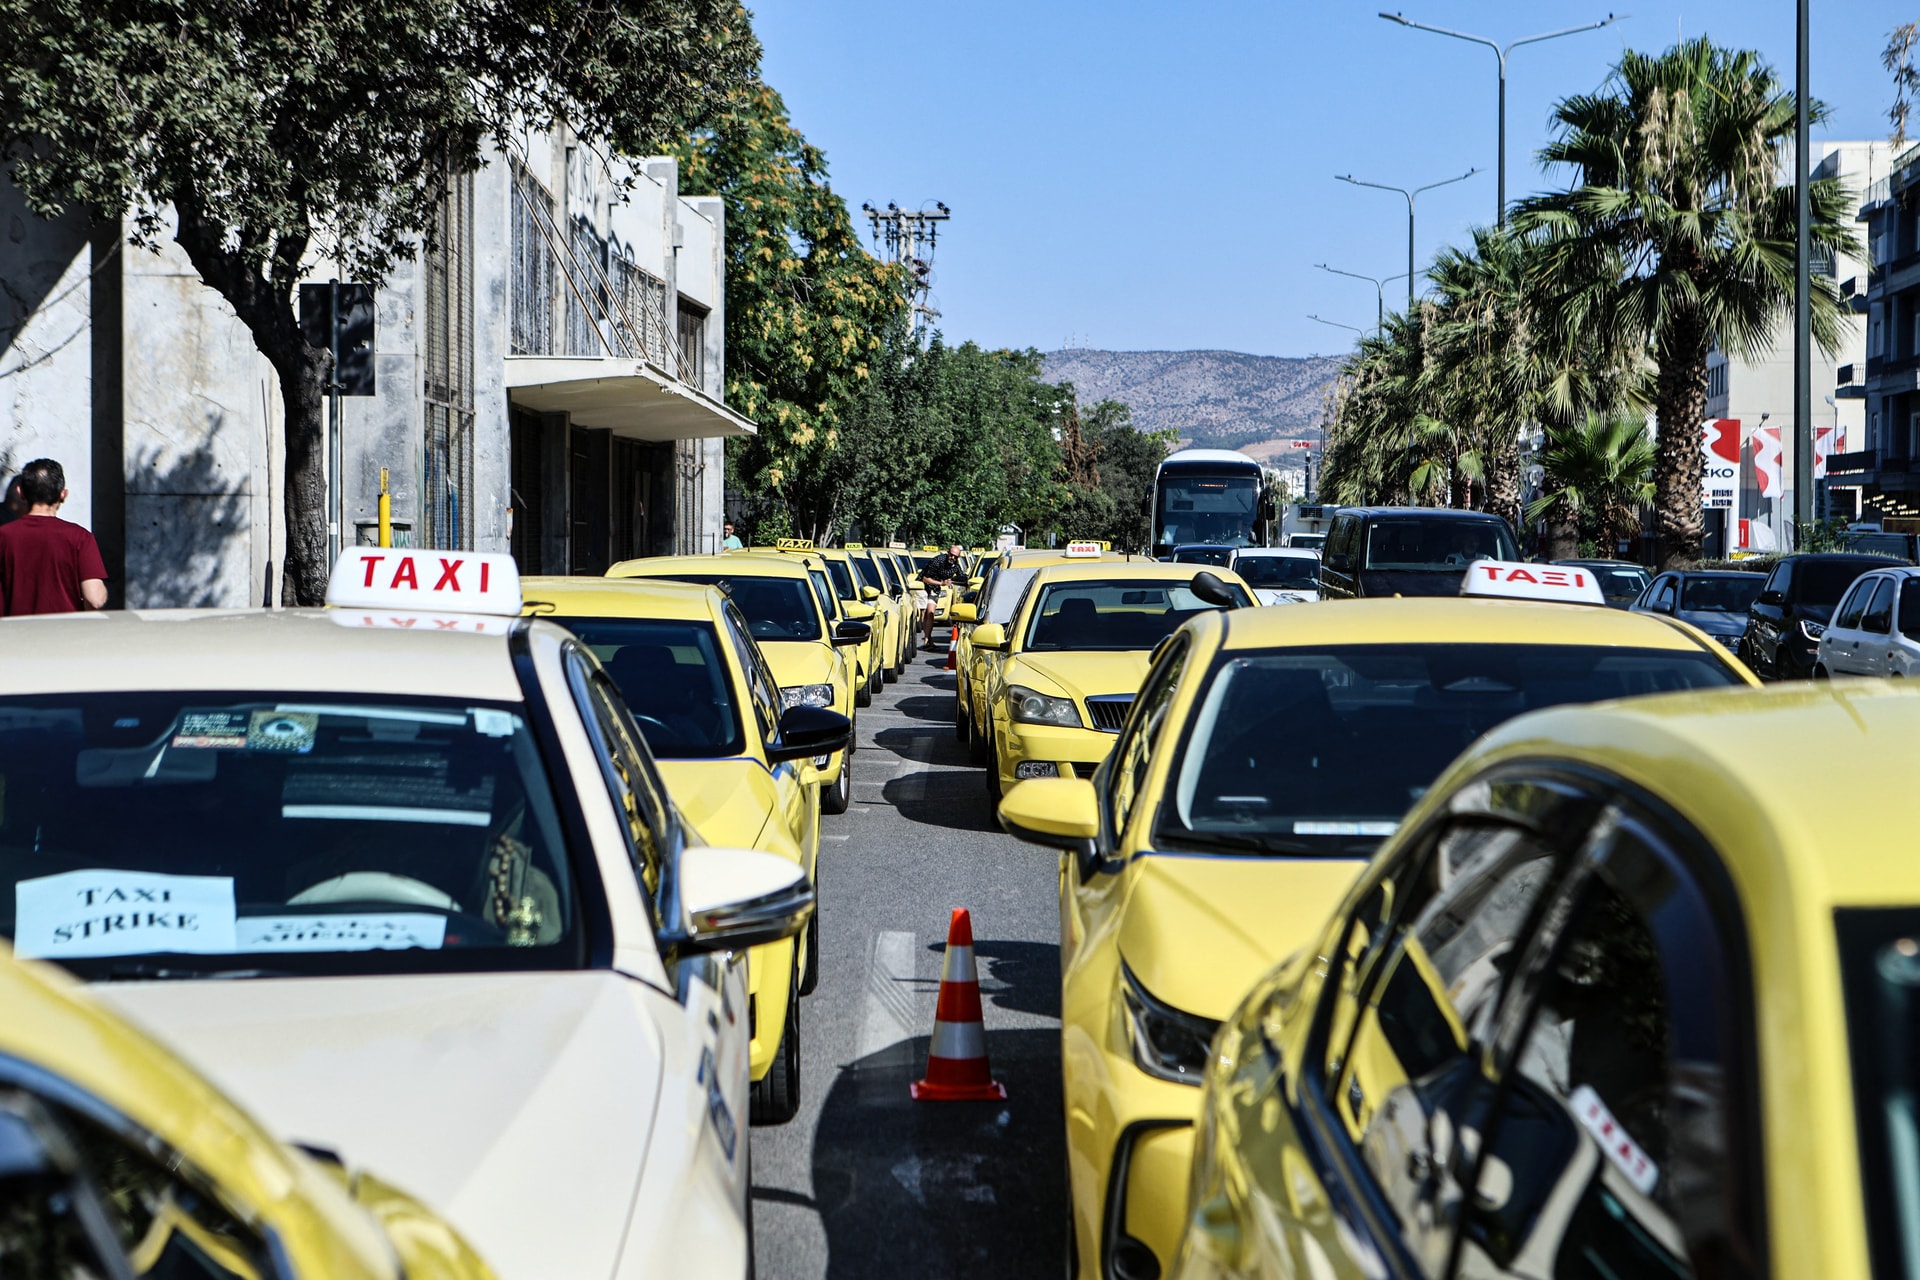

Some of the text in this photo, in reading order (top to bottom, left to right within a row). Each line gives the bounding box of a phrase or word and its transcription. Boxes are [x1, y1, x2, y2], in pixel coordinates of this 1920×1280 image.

[780, 540, 811, 549] TAXI
[360, 556, 489, 593] TAXI
[1479, 566, 1585, 588] ΤΑΞΙ
[77, 888, 170, 906] TAXI
[53, 912, 199, 944] STRIKE
